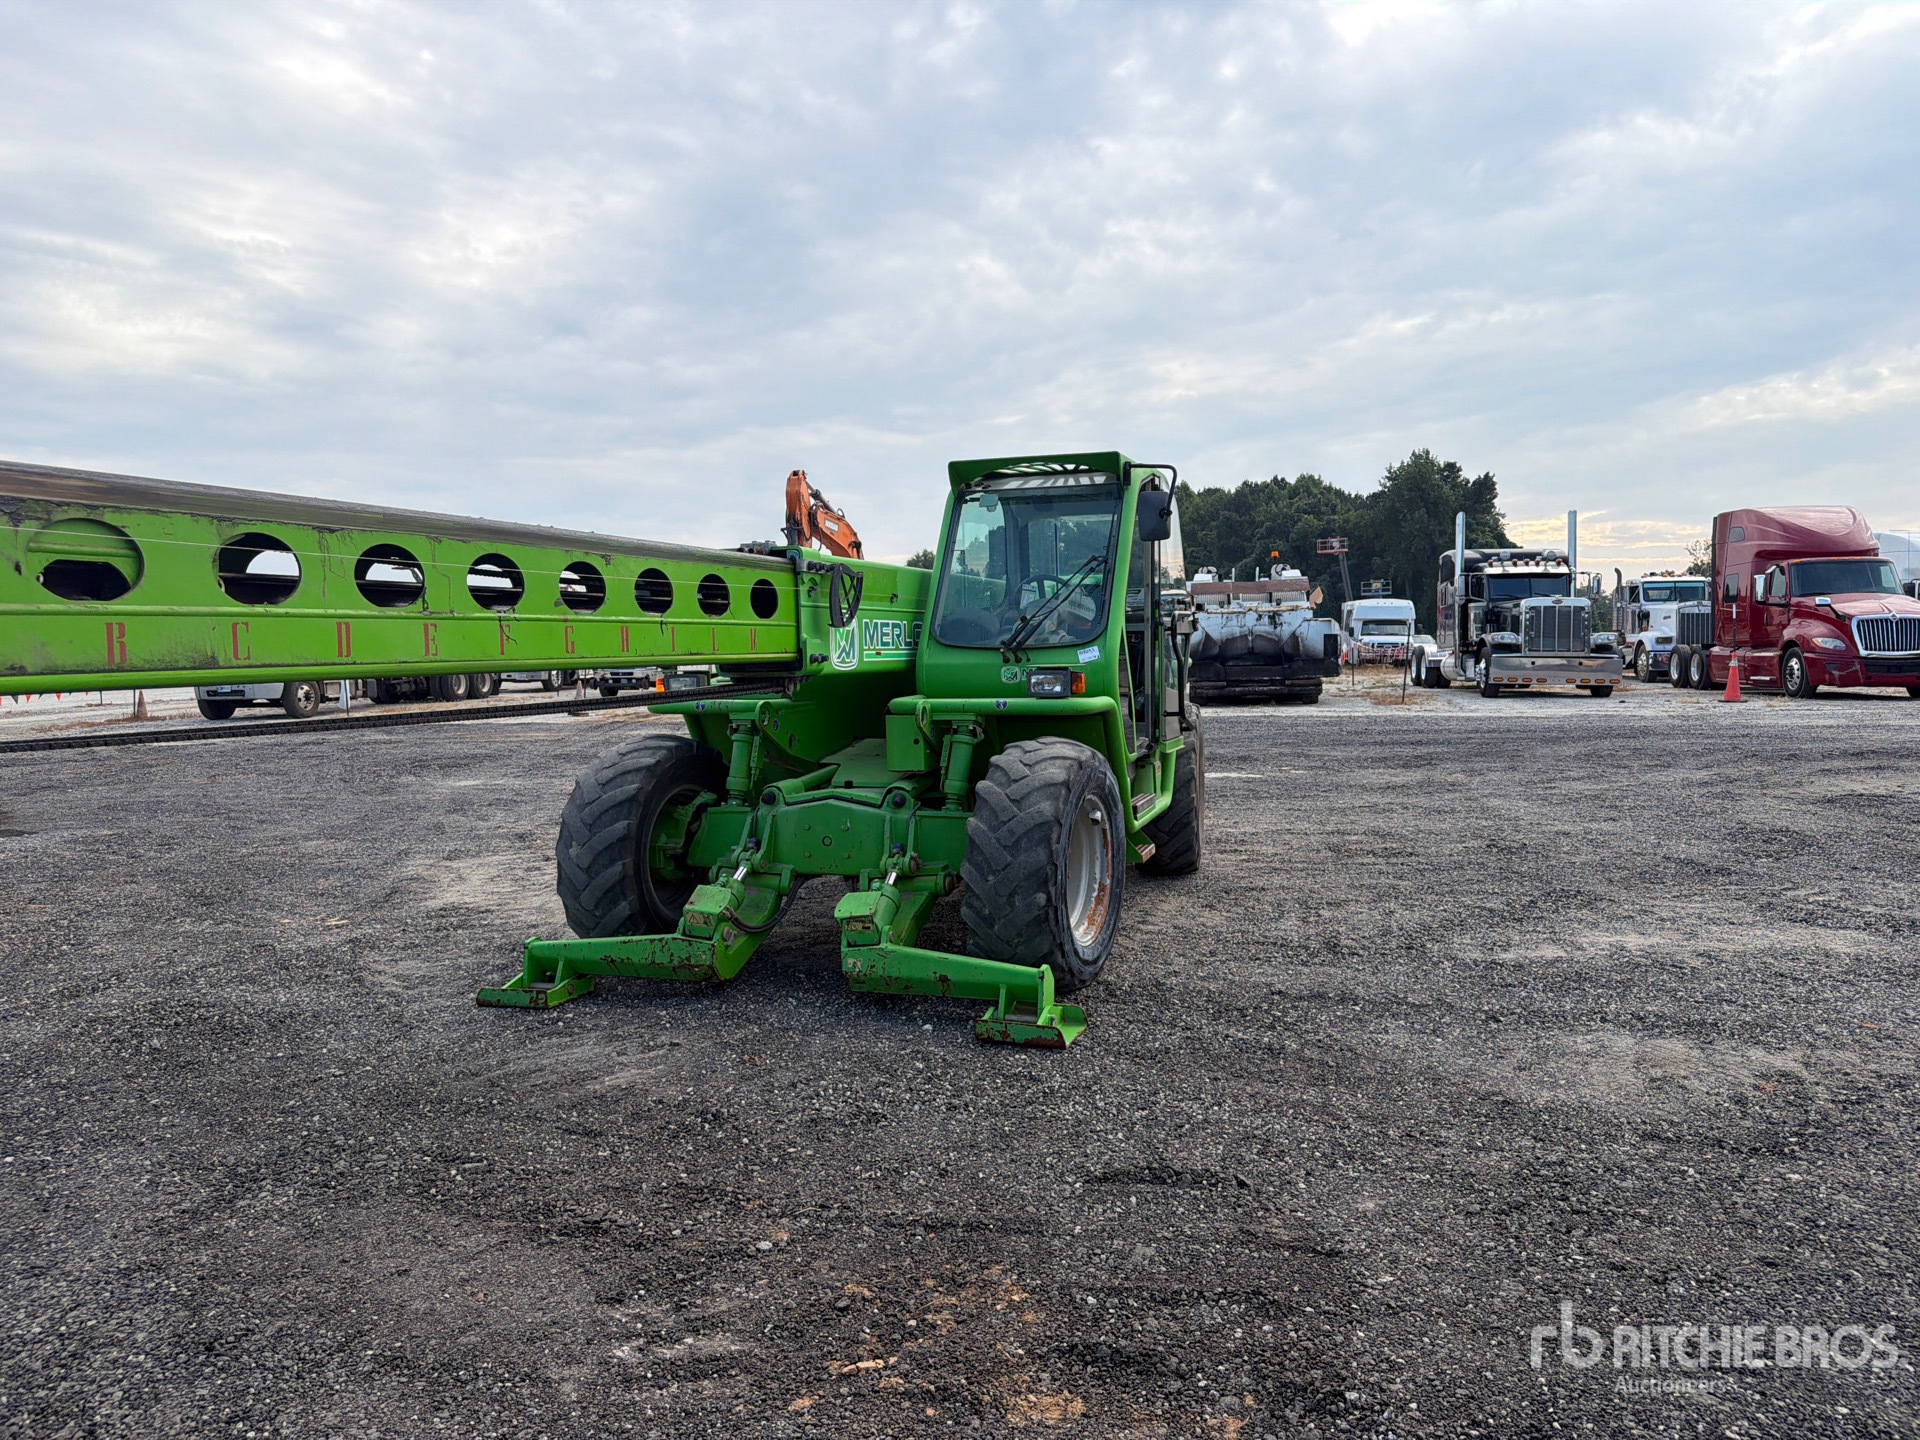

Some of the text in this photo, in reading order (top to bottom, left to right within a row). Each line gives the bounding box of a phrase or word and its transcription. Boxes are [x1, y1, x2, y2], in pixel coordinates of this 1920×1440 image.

[105, 622, 128, 666] B
[231, 622, 251, 660] C
[336, 622, 352, 659] D
[423, 622, 439, 657] E
[499, 623, 511, 656] F
[564, 625, 576, 655] G
